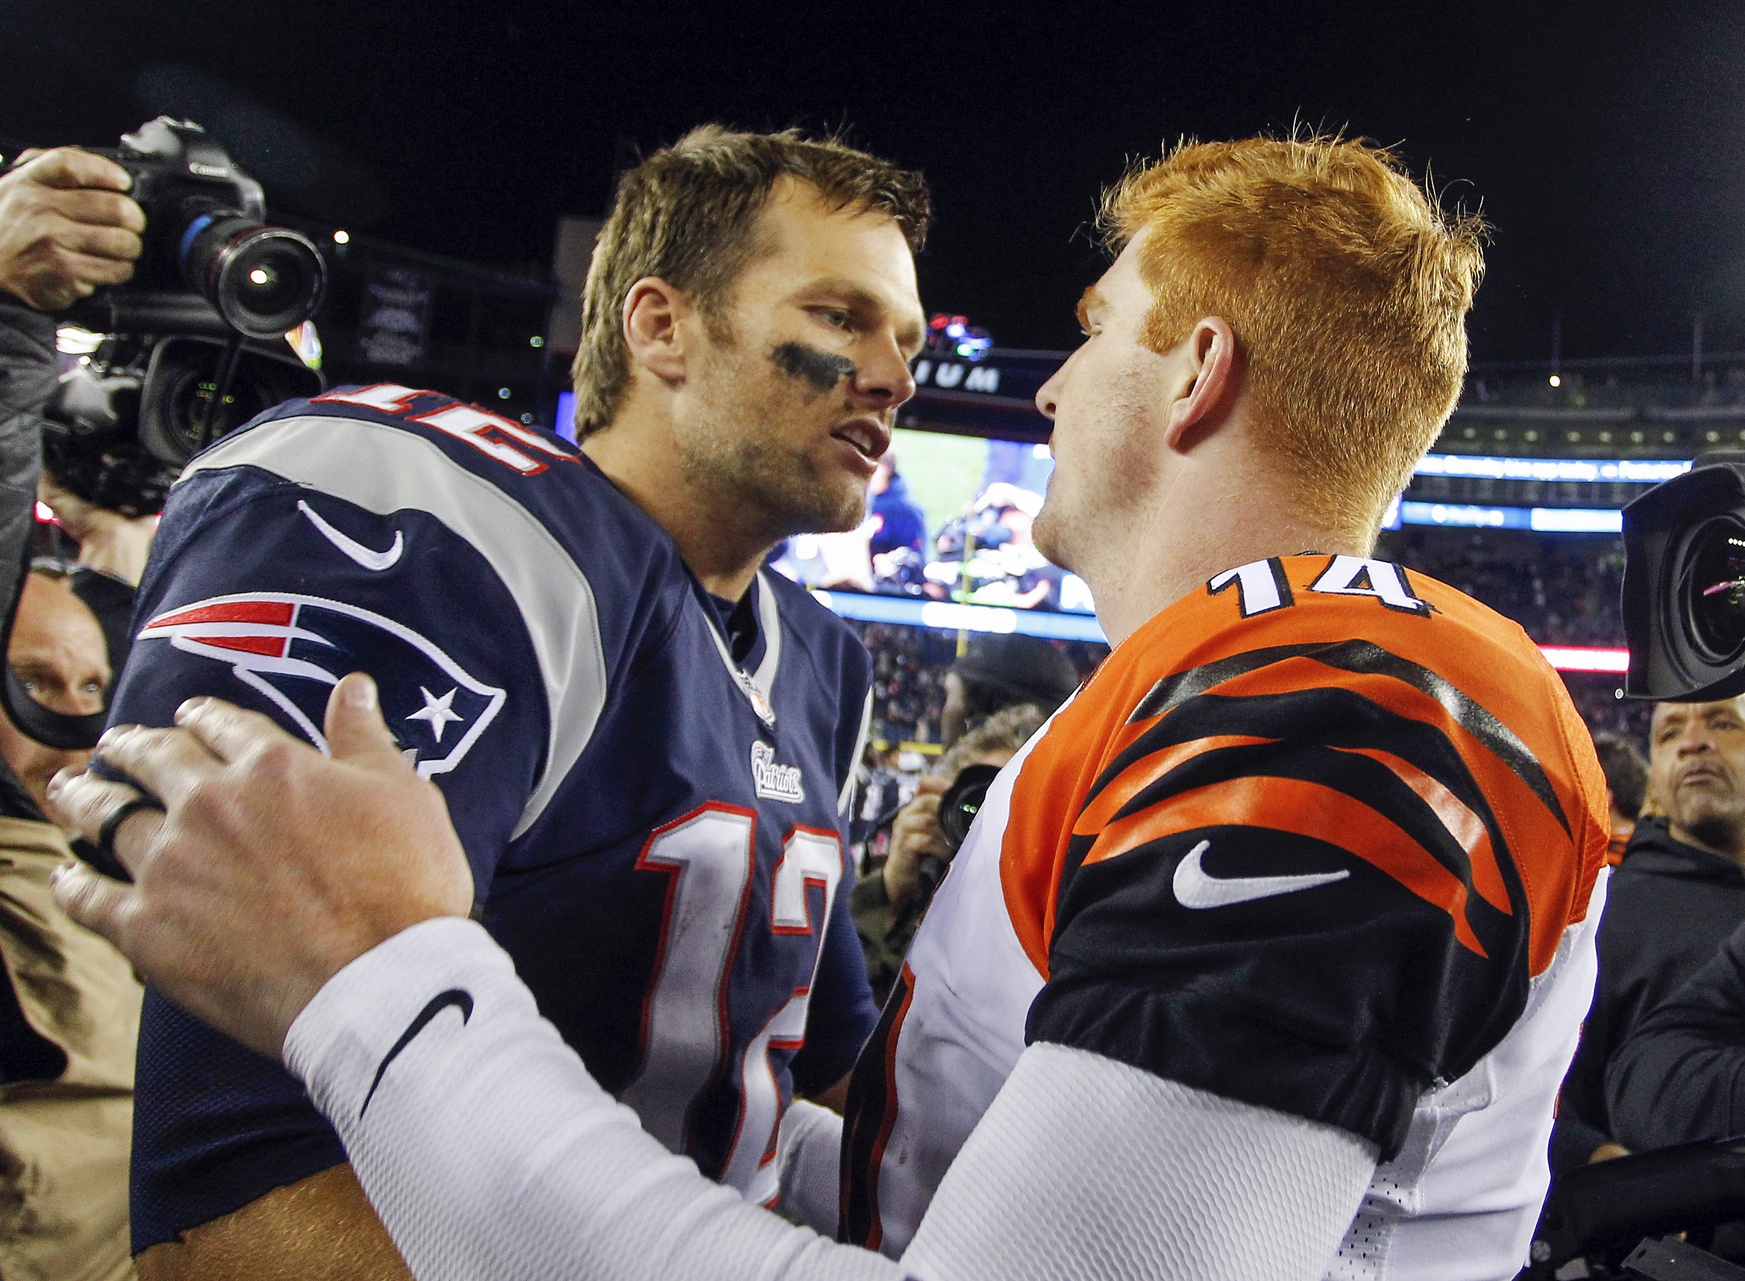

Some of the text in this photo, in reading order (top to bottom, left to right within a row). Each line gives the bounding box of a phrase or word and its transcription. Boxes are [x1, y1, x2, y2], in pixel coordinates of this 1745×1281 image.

[1206, 554, 1440, 619] 14
[754, 757, 801, 795] Patriots
[628, 800, 844, 1209] 12
